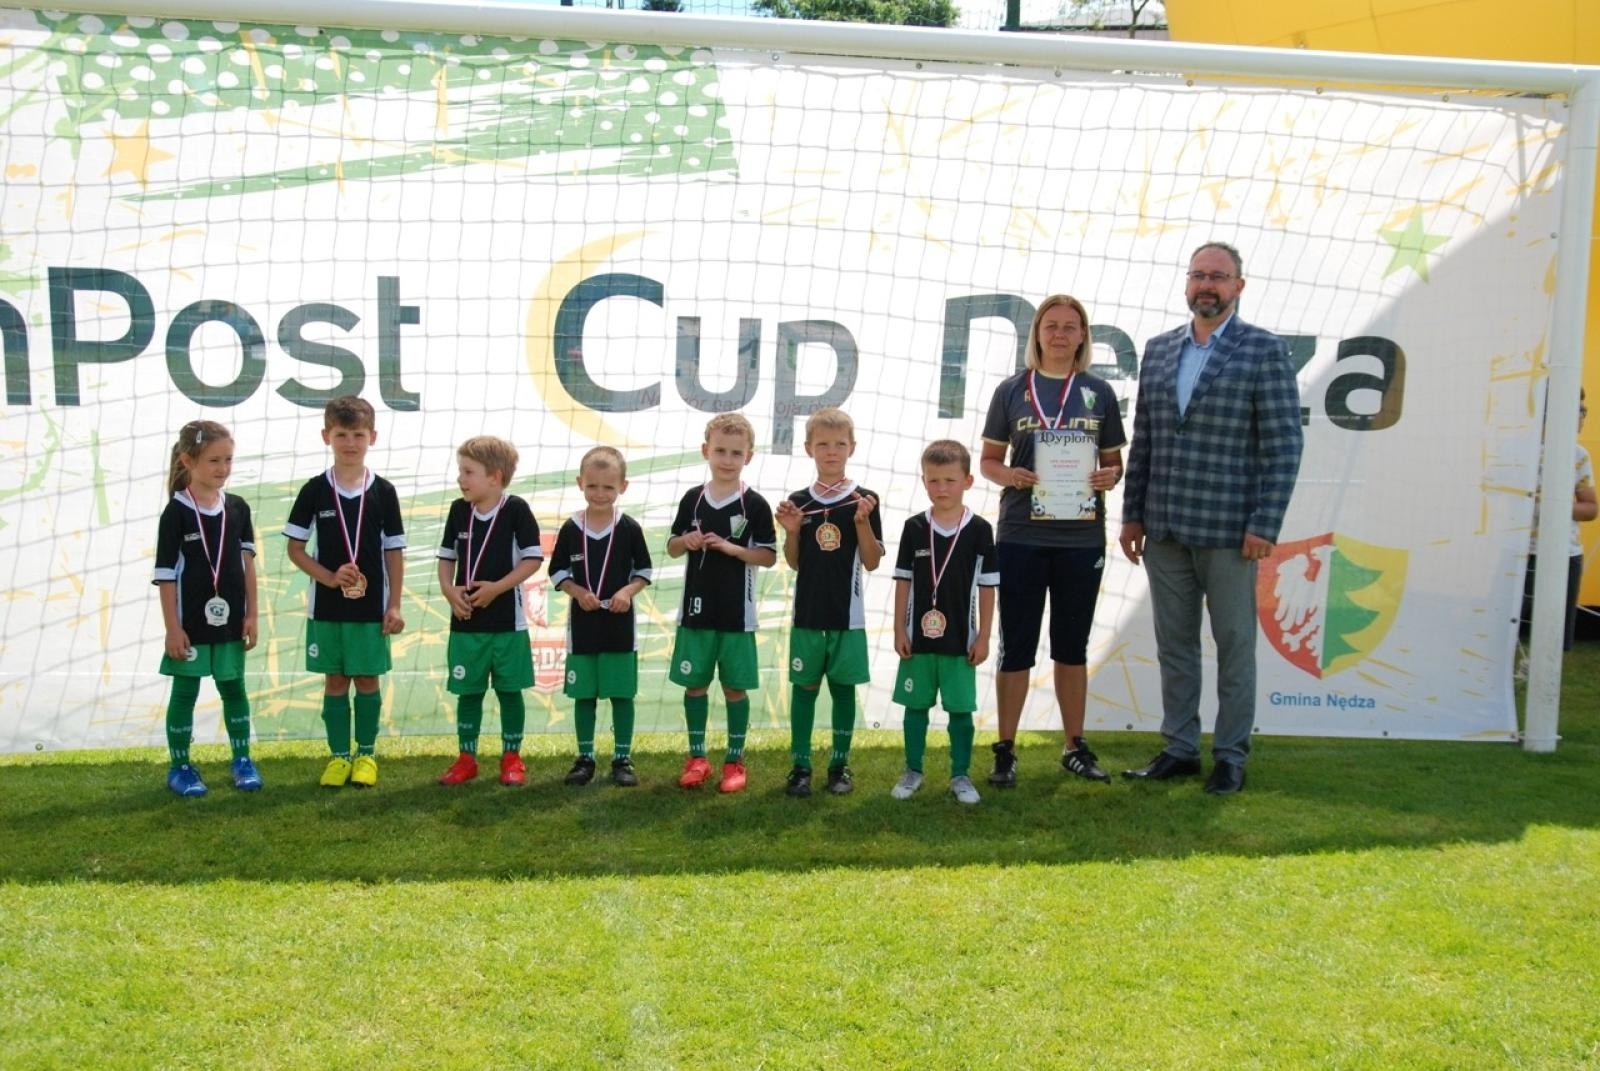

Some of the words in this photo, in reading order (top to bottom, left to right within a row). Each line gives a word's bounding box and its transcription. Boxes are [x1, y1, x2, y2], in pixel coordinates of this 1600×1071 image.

[553, 272, 859, 455] Cup
[1269, 691, 1321, 706] Gmina
[1326, 693, 1376, 710] Nędza
